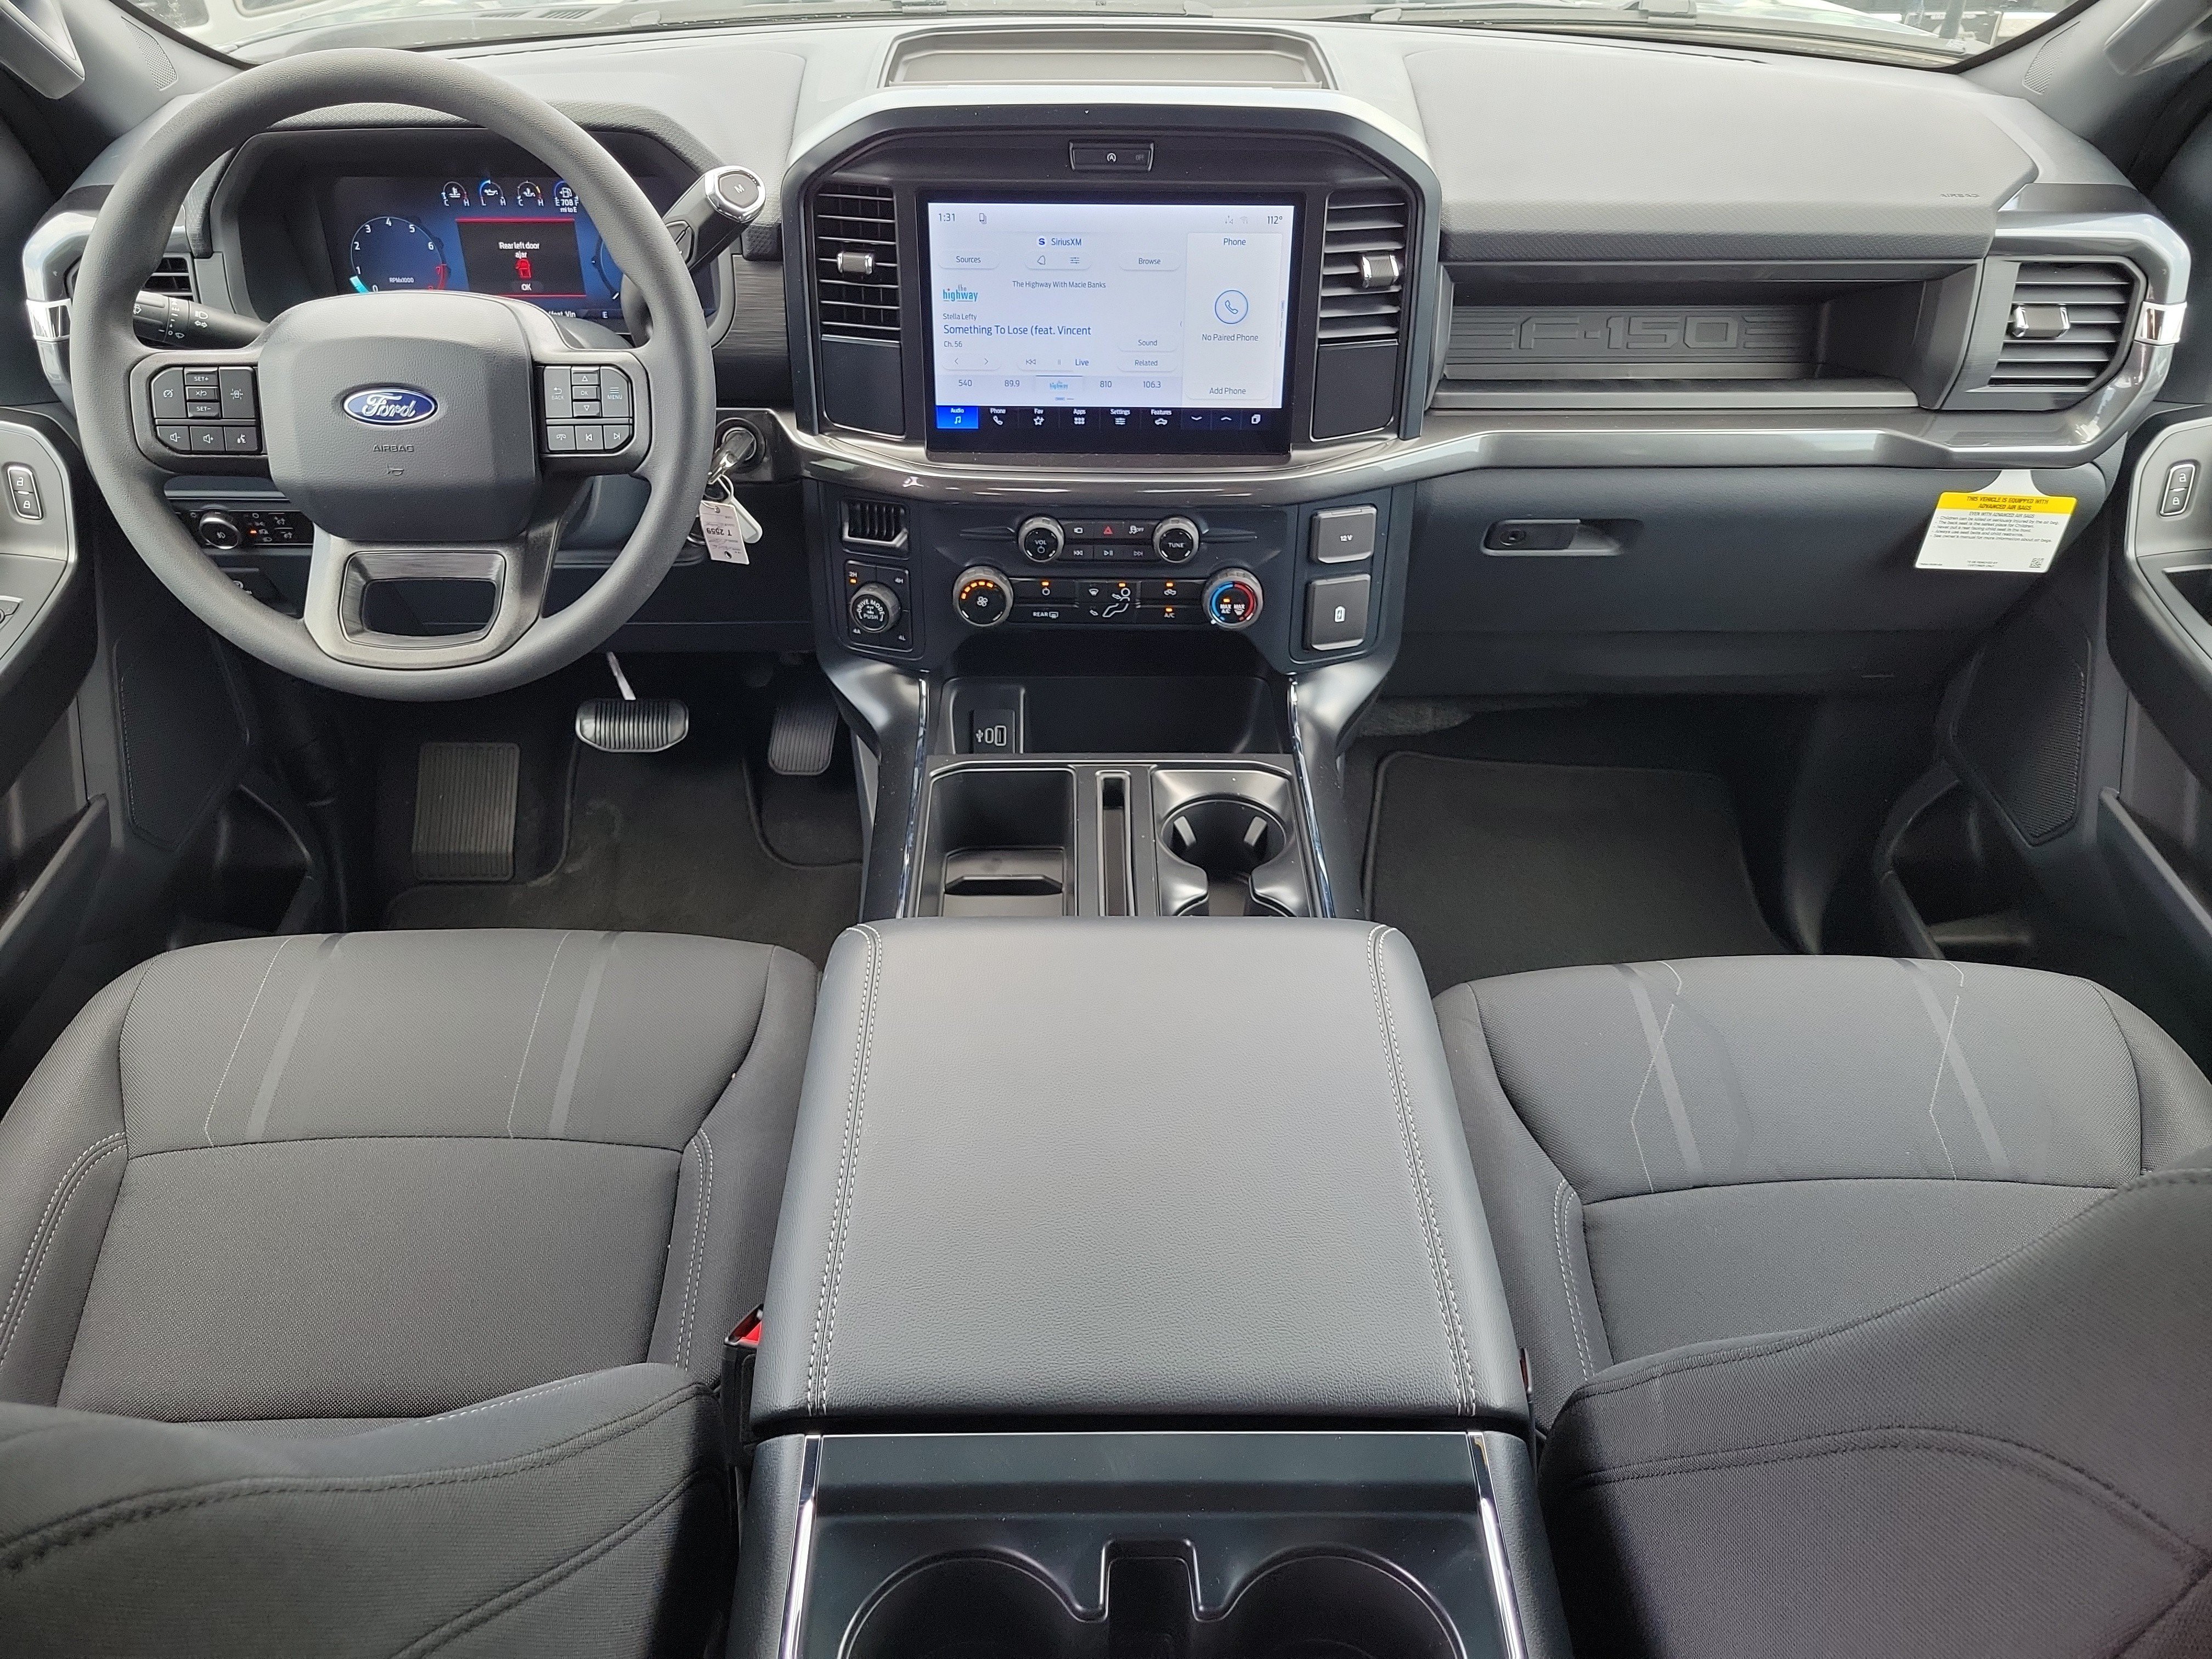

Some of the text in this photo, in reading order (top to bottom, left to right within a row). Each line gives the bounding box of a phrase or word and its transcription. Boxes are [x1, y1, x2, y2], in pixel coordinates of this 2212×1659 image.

[734, 184, 745, 194] M
[463, 199, 470, 207] H
[386, 217, 392, 227] 4
[939, 213, 955, 222] 1:31
[1267, 216, 1283, 224] 112°
[365, 224, 371, 233] 3
[409, 224, 415, 233] 5
[354, 241, 360, 250] 2
[428, 241, 434, 250] 6
[1051, 238, 1082, 246] SiriusXM
[515, 250, 527, 259] ajar
[356, 266, 361, 275] 1
[521, 283, 532, 291] OK
[943, 288, 978, 302] highway
[962, 313, 977, 321] Lefty
[944, 325, 1091, 336] Something To Lose (feat. Vincent
[1519, 316, 1739, 349] F-150
[362, 393, 417, 417] Ford
[373, 444, 415, 453] AIRBAG
[856, 599, 885, 615] DRIVE MODE
